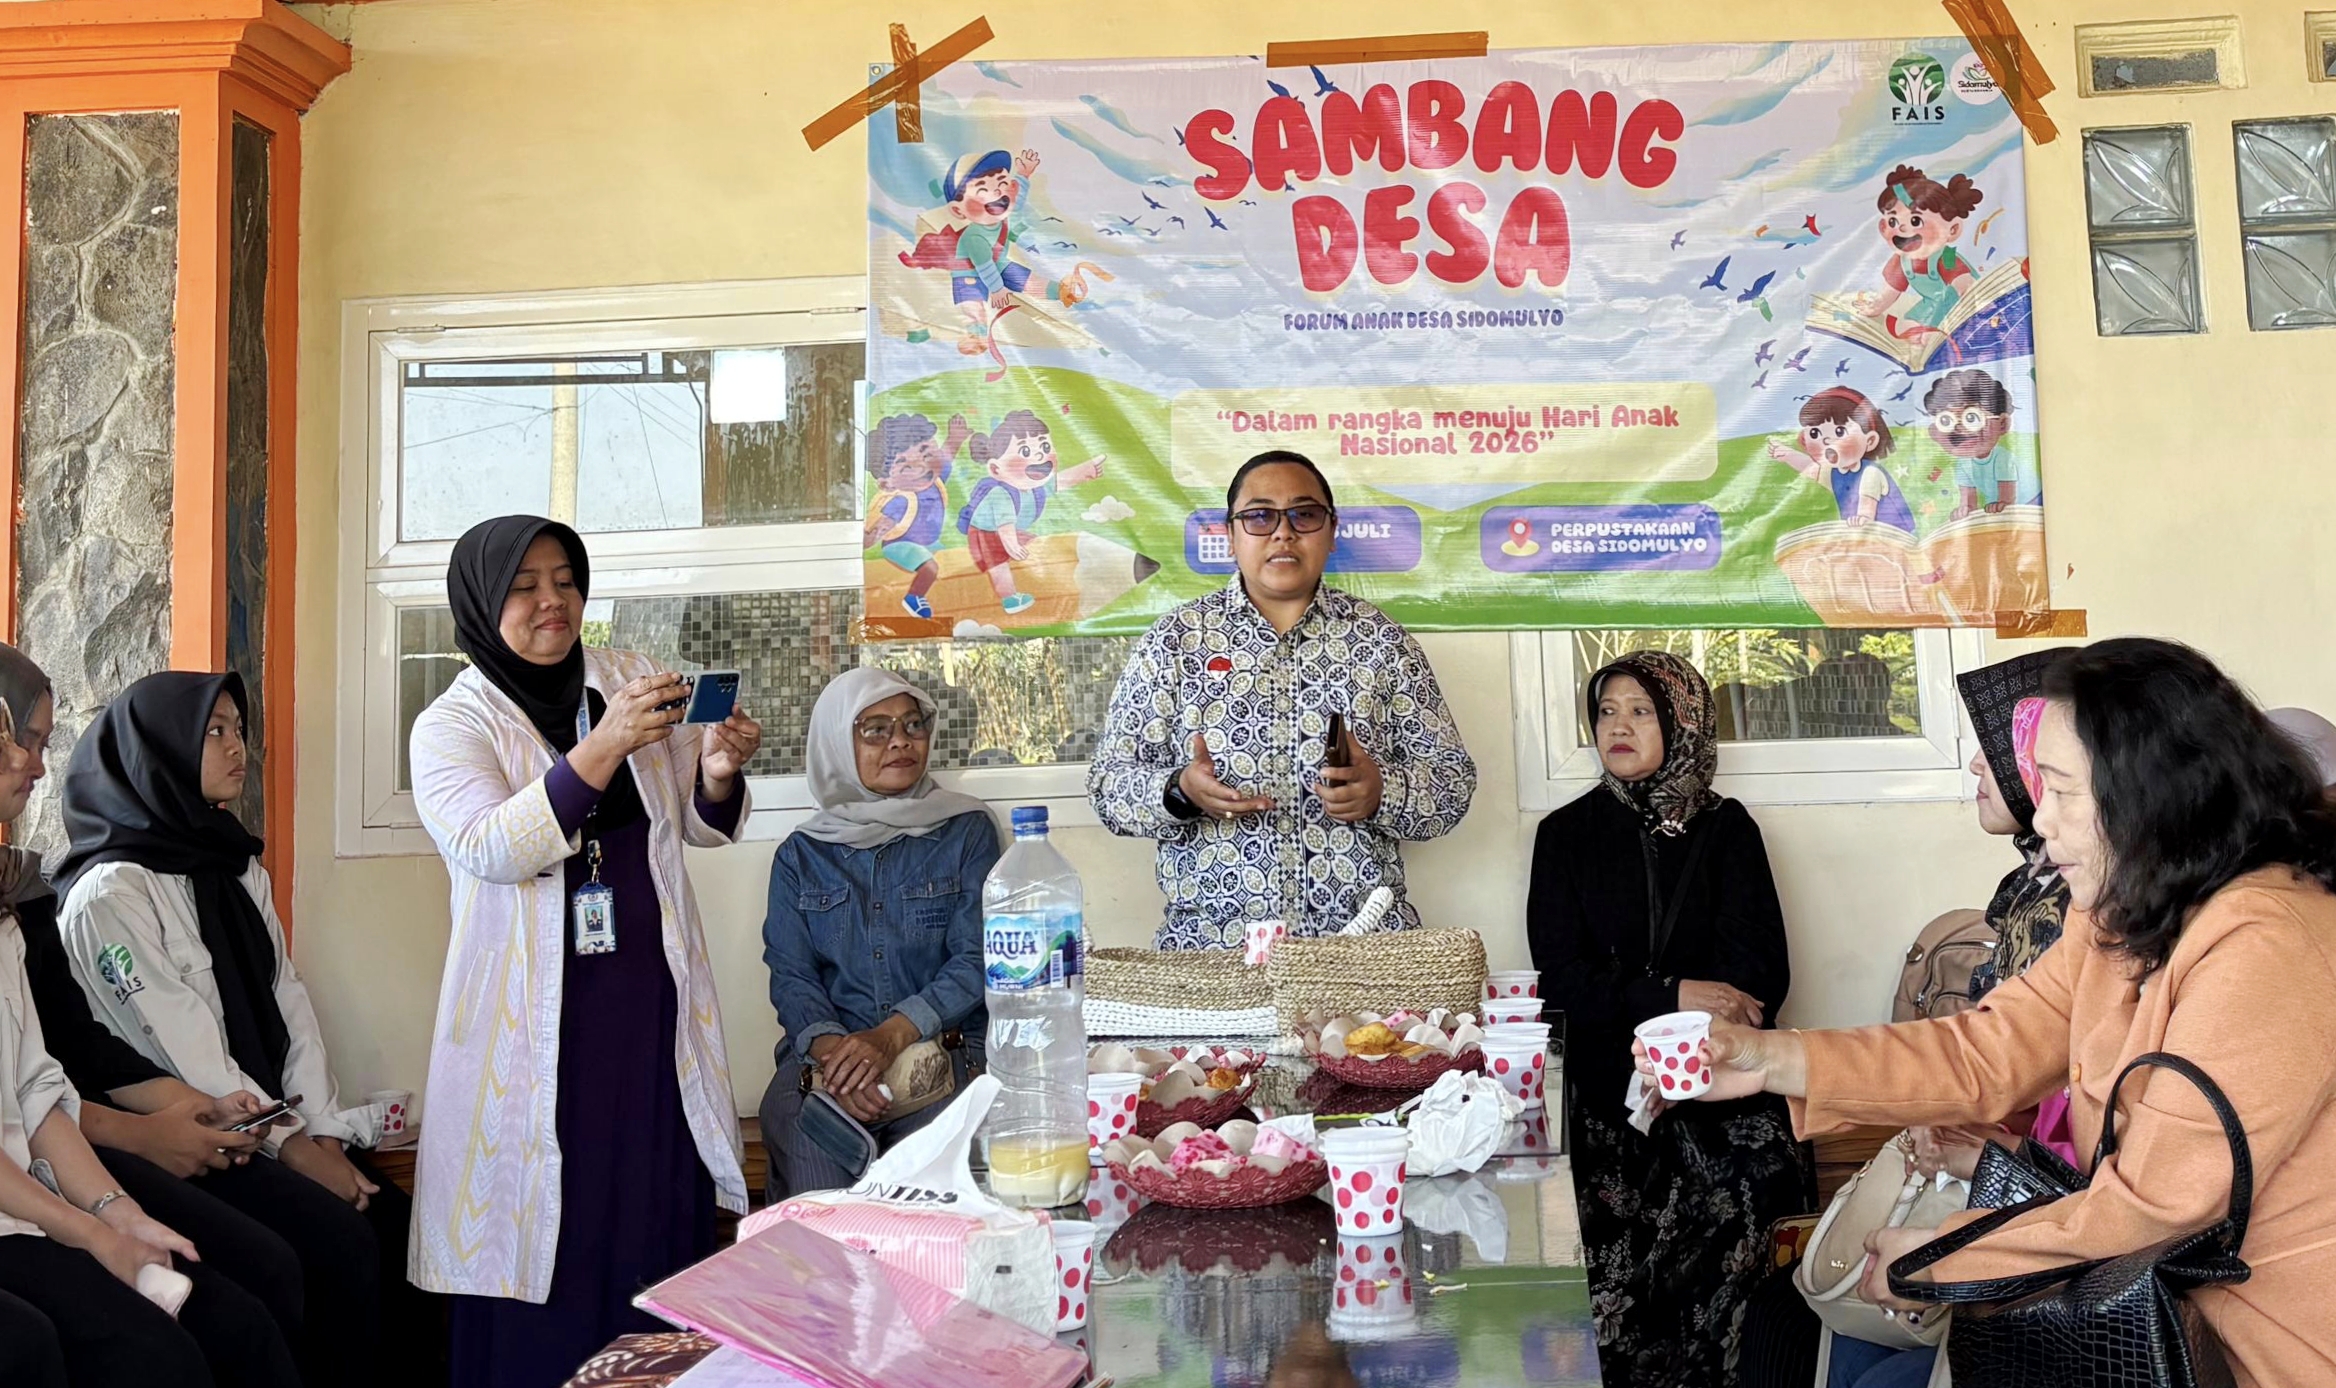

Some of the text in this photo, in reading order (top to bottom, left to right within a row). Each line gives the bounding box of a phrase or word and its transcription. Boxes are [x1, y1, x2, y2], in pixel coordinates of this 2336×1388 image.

[1891, 105, 1946, 121] FAIS
[1184, 79, 1685, 200] SAMBANG
[1291, 181, 1571, 292] DESA
[1283, 308, 1565, 331] FORUM ANAK DESA SIDOMULYO
[1327, 408, 1423, 436] rangka
[1432, 404, 1532, 440] menuju
[1541, 404, 1600, 428] Hari
[1610, 404, 1680, 428] Anak
[1340, 431, 1458, 456] Nasional
[1340, 523, 1392, 539] JULI
[1550, 521, 1696, 537] PERPUSTAKAAN
[1550, 537, 1708, 554] DESA SIDOMULYO
[984, 929, 1039, 960] AQUA
